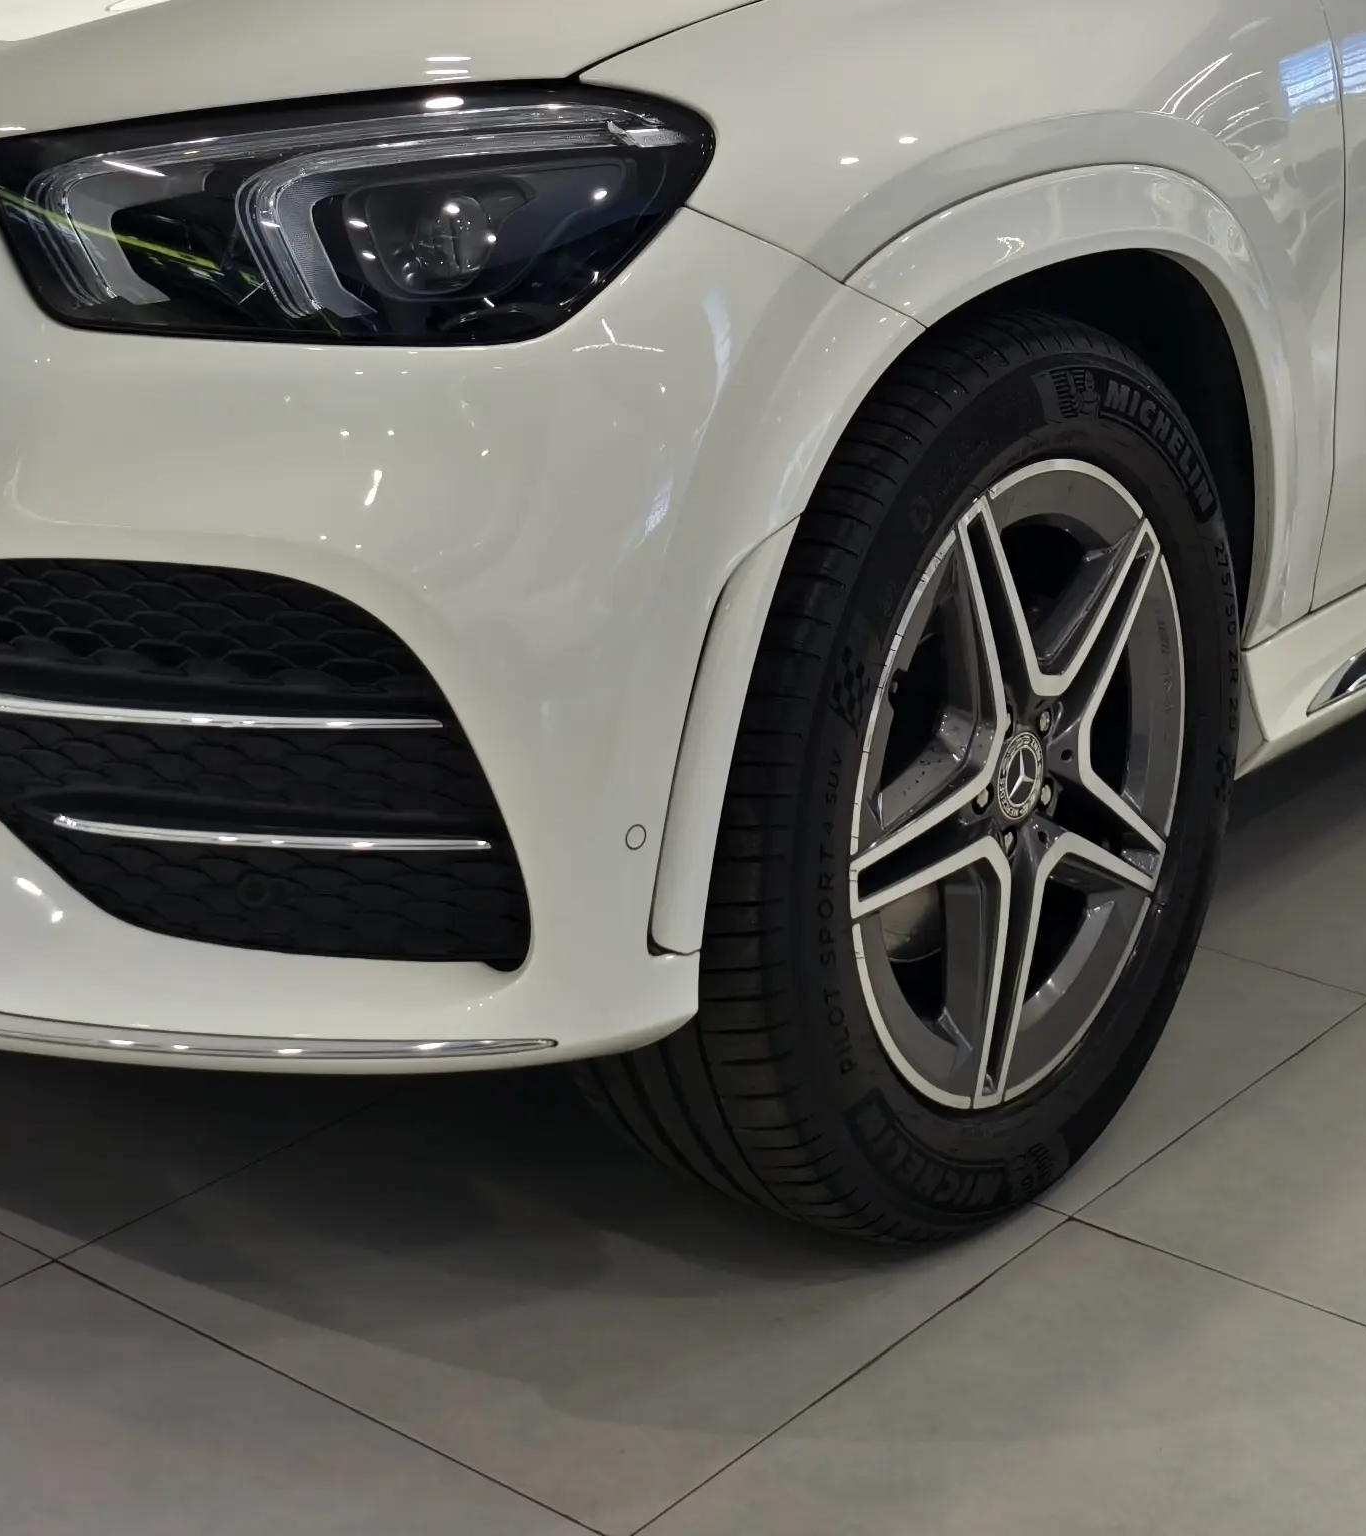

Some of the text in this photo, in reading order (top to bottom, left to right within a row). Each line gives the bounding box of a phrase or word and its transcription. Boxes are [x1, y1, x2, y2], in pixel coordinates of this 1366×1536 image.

[1104, 379, 1214, 512] MICHELIN
[824, 749, 843, 805] SUV
[817, 843, 836, 967] SPORT
[822, 986, 858, 1076] PILOT
[856, 1101, 1006, 1208] MICHELIN
